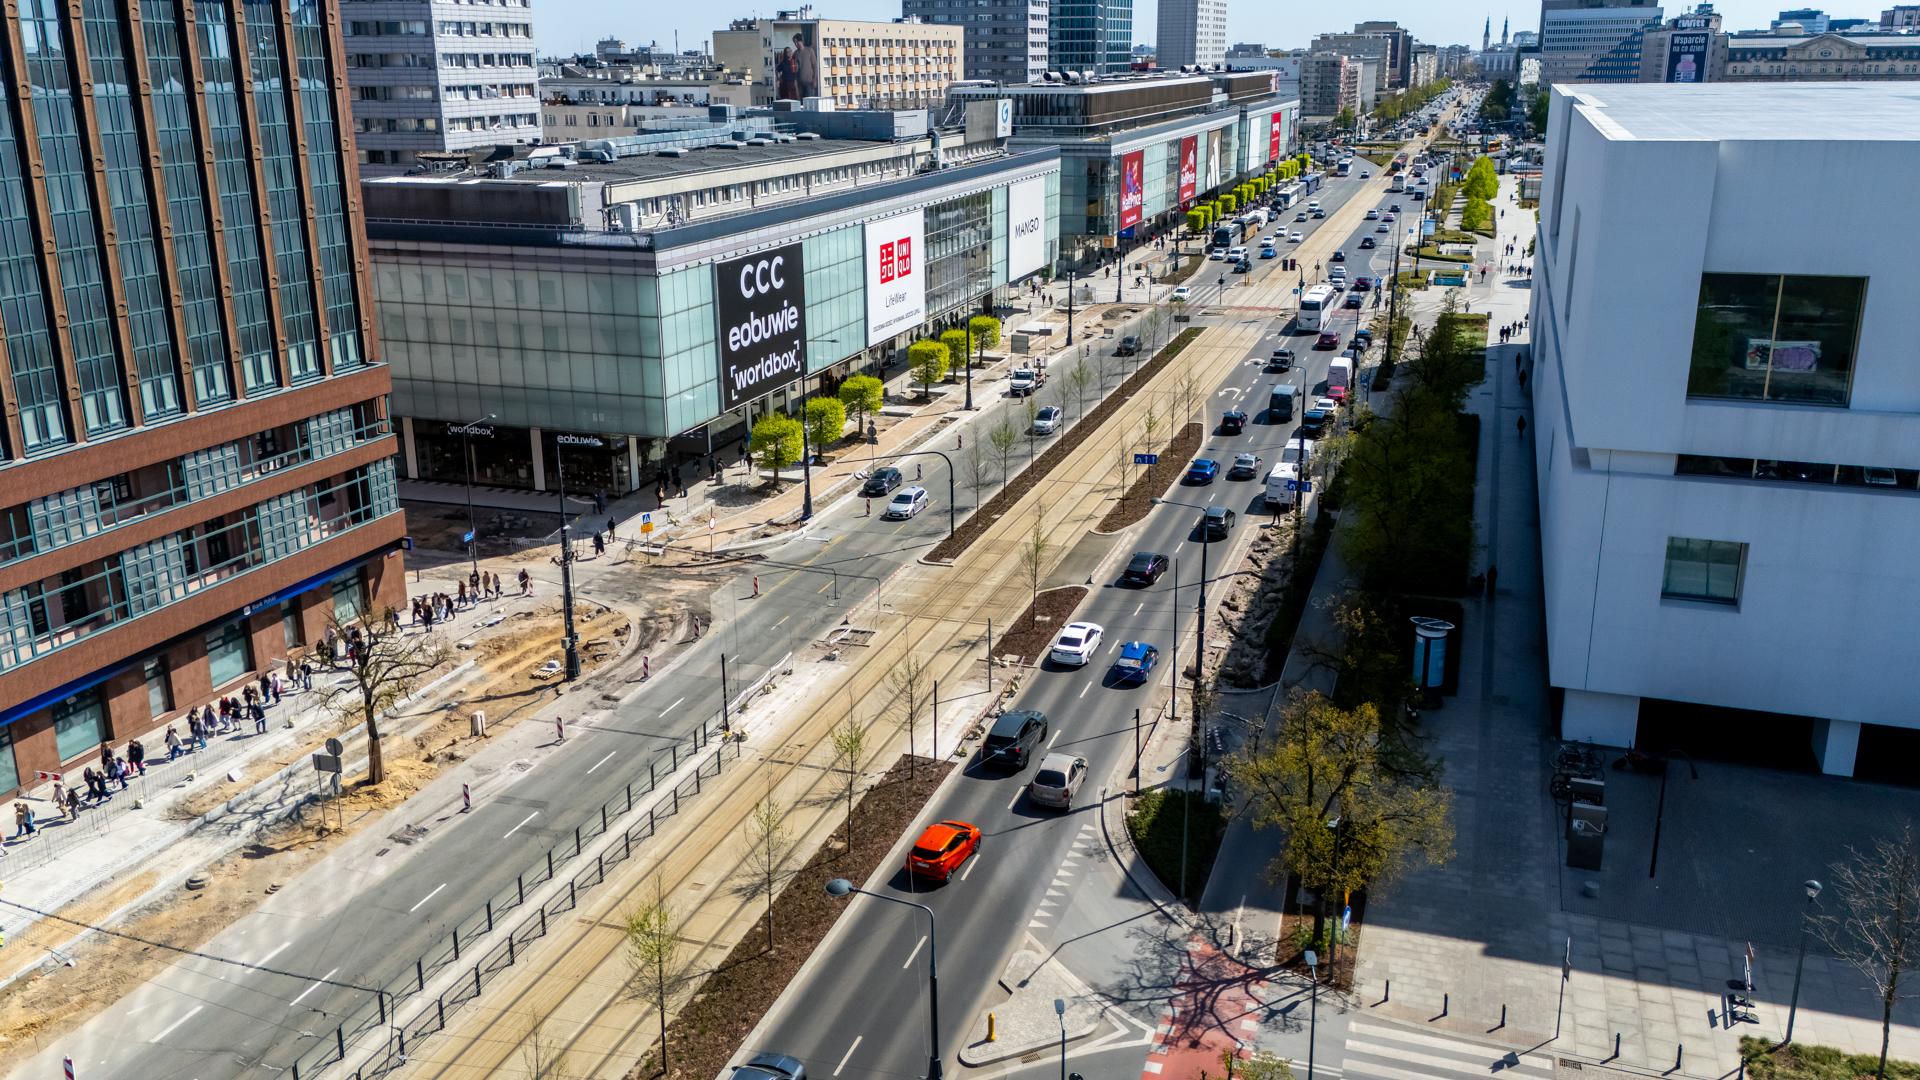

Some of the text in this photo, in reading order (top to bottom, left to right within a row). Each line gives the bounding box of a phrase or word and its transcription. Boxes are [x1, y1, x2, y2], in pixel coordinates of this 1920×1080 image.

[1673, 35, 1706, 45] Wsparcie
[1015, 217, 1040, 238] MANGO
[740, 255, 785, 299] CCC
[728, 299, 799, 352] eobuwie
